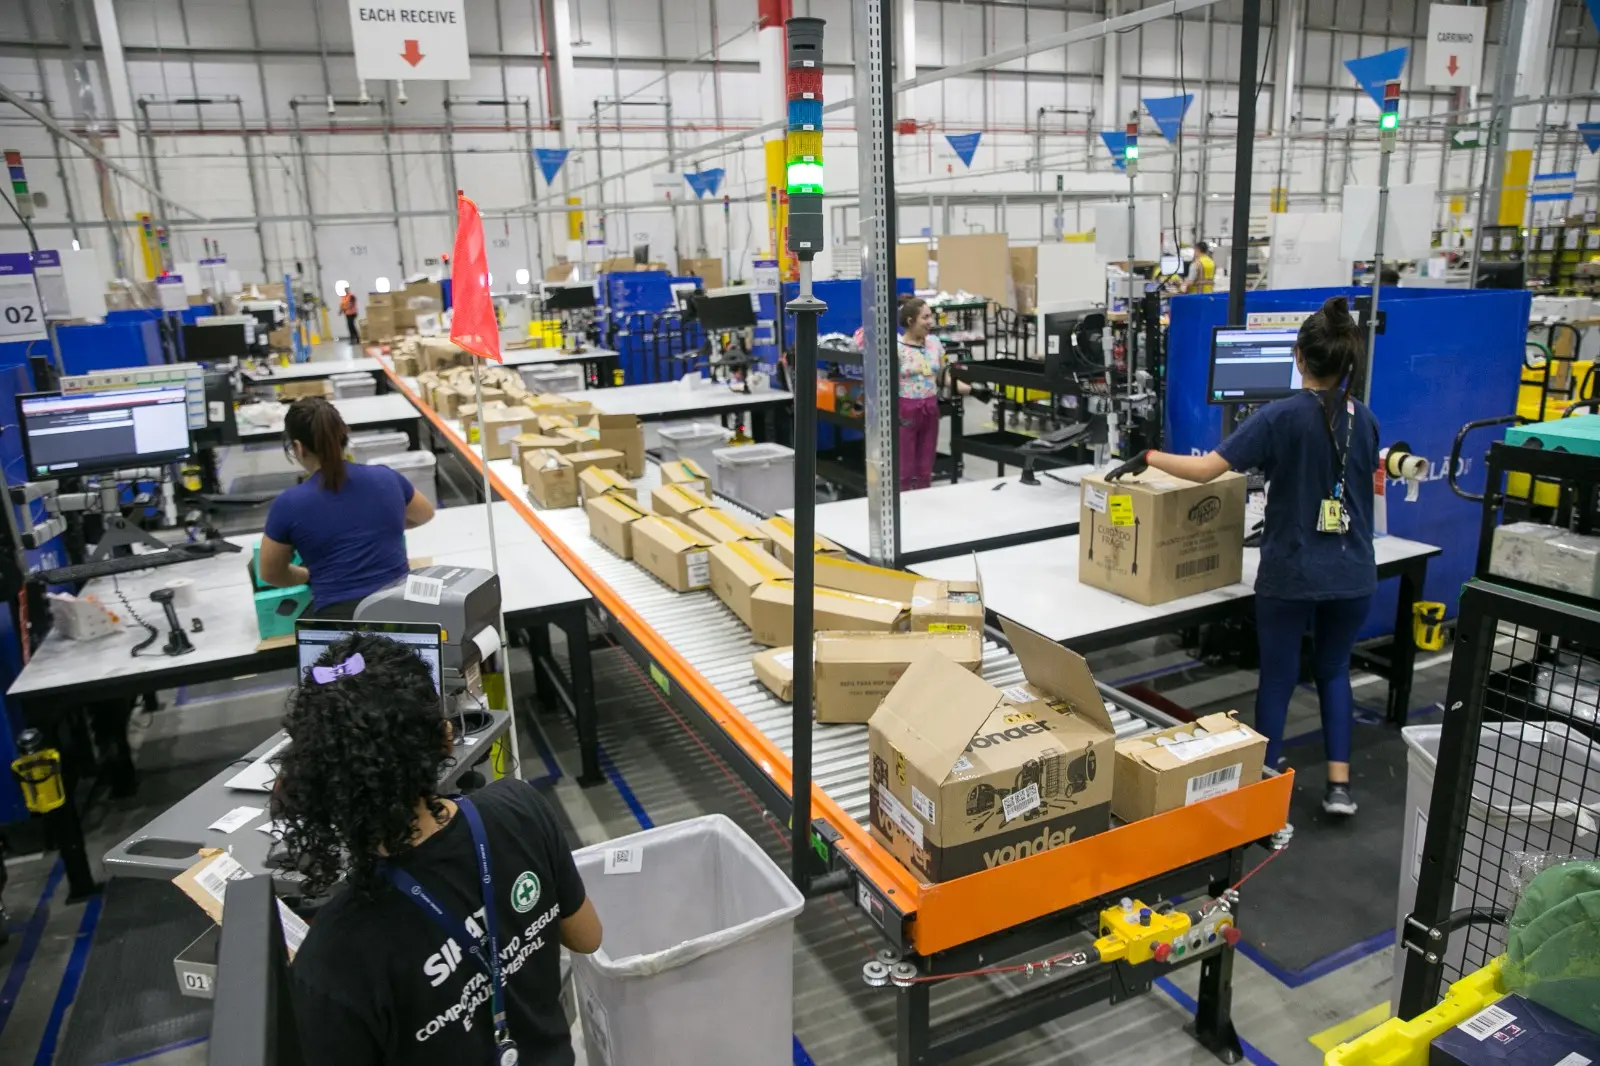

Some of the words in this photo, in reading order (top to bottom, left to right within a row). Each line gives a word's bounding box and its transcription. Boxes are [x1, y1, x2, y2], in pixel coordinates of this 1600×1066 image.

[359, 8, 396, 22] EACH
[400, 9, 457, 24] RECEIVE
[1437, 32, 1474, 44] CARRINHO
[4, 305, 38, 325] 02
[983, 826, 1077, 870] vonder
[186, 974, 205, 989] 01
